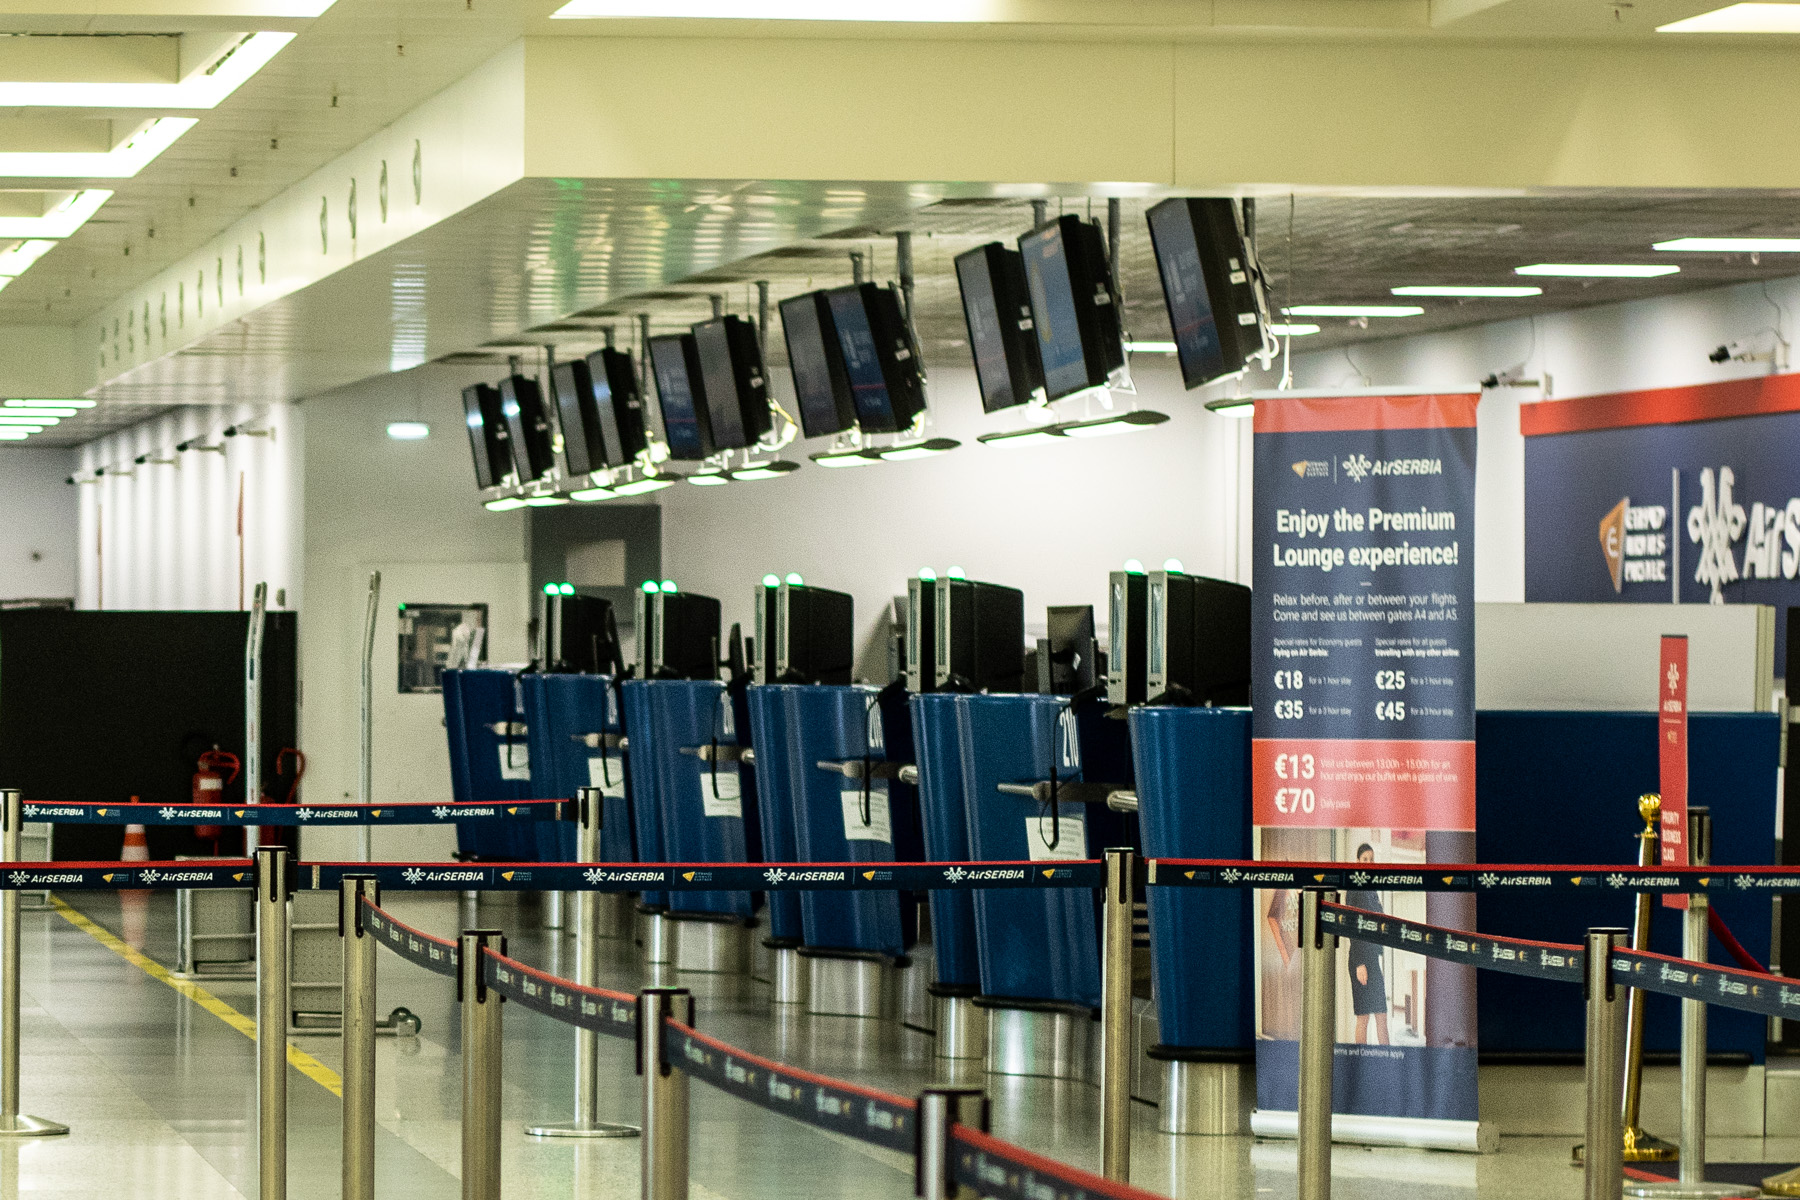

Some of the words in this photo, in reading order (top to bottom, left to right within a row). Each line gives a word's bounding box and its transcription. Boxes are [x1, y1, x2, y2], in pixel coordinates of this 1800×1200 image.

[1371, 459, 1442, 476] AirSERBIA
[1276, 509, 1329, 538] Enjoy
[1333, 507, 1364, 532] the
[1369, 506, 1455, 532] Premium
[1743, 497, 1800, 580] AirS
[1273, 543, 1344, 572] Lounge
[1348, 541, 1459, 571] experience!
[1273, 593, 1297, 606] Relax
[1333, 593, 1353, 606] after
[1355, 596, 1364, 606] or
[1368, 593, 1406, 606] between
[1409, 596, 1428, 609] your
[1274, 609, 1299, 621] Come
[1301, 609, 1318, 621] and
[1320, 611, 1335, 621] see
[1337, 611, 1347, 621] us
[1349, 609, 1385, 621] between
[1388, 610, 1412, 623] gates
[1415, 609, 1426, 620] A4
[1429, 609, 1444, 620] and
[1274, 670, 1303, 690] €18
[1375, 670, 1405, 690] €25
[1274, 700, 1303, 719] €35
[1375, 701, 1405, 720] €45
[1275, 753, 1315, 779] €13
[1275, 788, 1315, 814] €70
[38, 808, 84, 816] AirSERBIA
[312, 810, 358, 818] AirSERBIA
[449, 808, 494, 816] AirSERBIA
[29, 874, 83, 883] AirSERBIA
[159, 872, 213, 881] AirSERBIA
[424, 872, 483, 881] AirSERBIA
[606, 872, 664, 881] AirSERBIA
[786, 872, 844, 881] AirSERBIA
[966, 870, 1024, 879] AirSERBIA
[1241, 873, 1294, 881] AirSERBIA
[1372, 875, 1423, 884] AirSERBIA
[1500, 876, 1551, 885] AirSERBIA
[1629, 877, 1679, 886] AirSERBIA
[1756, 878, 1800, 888] AirSERBI
